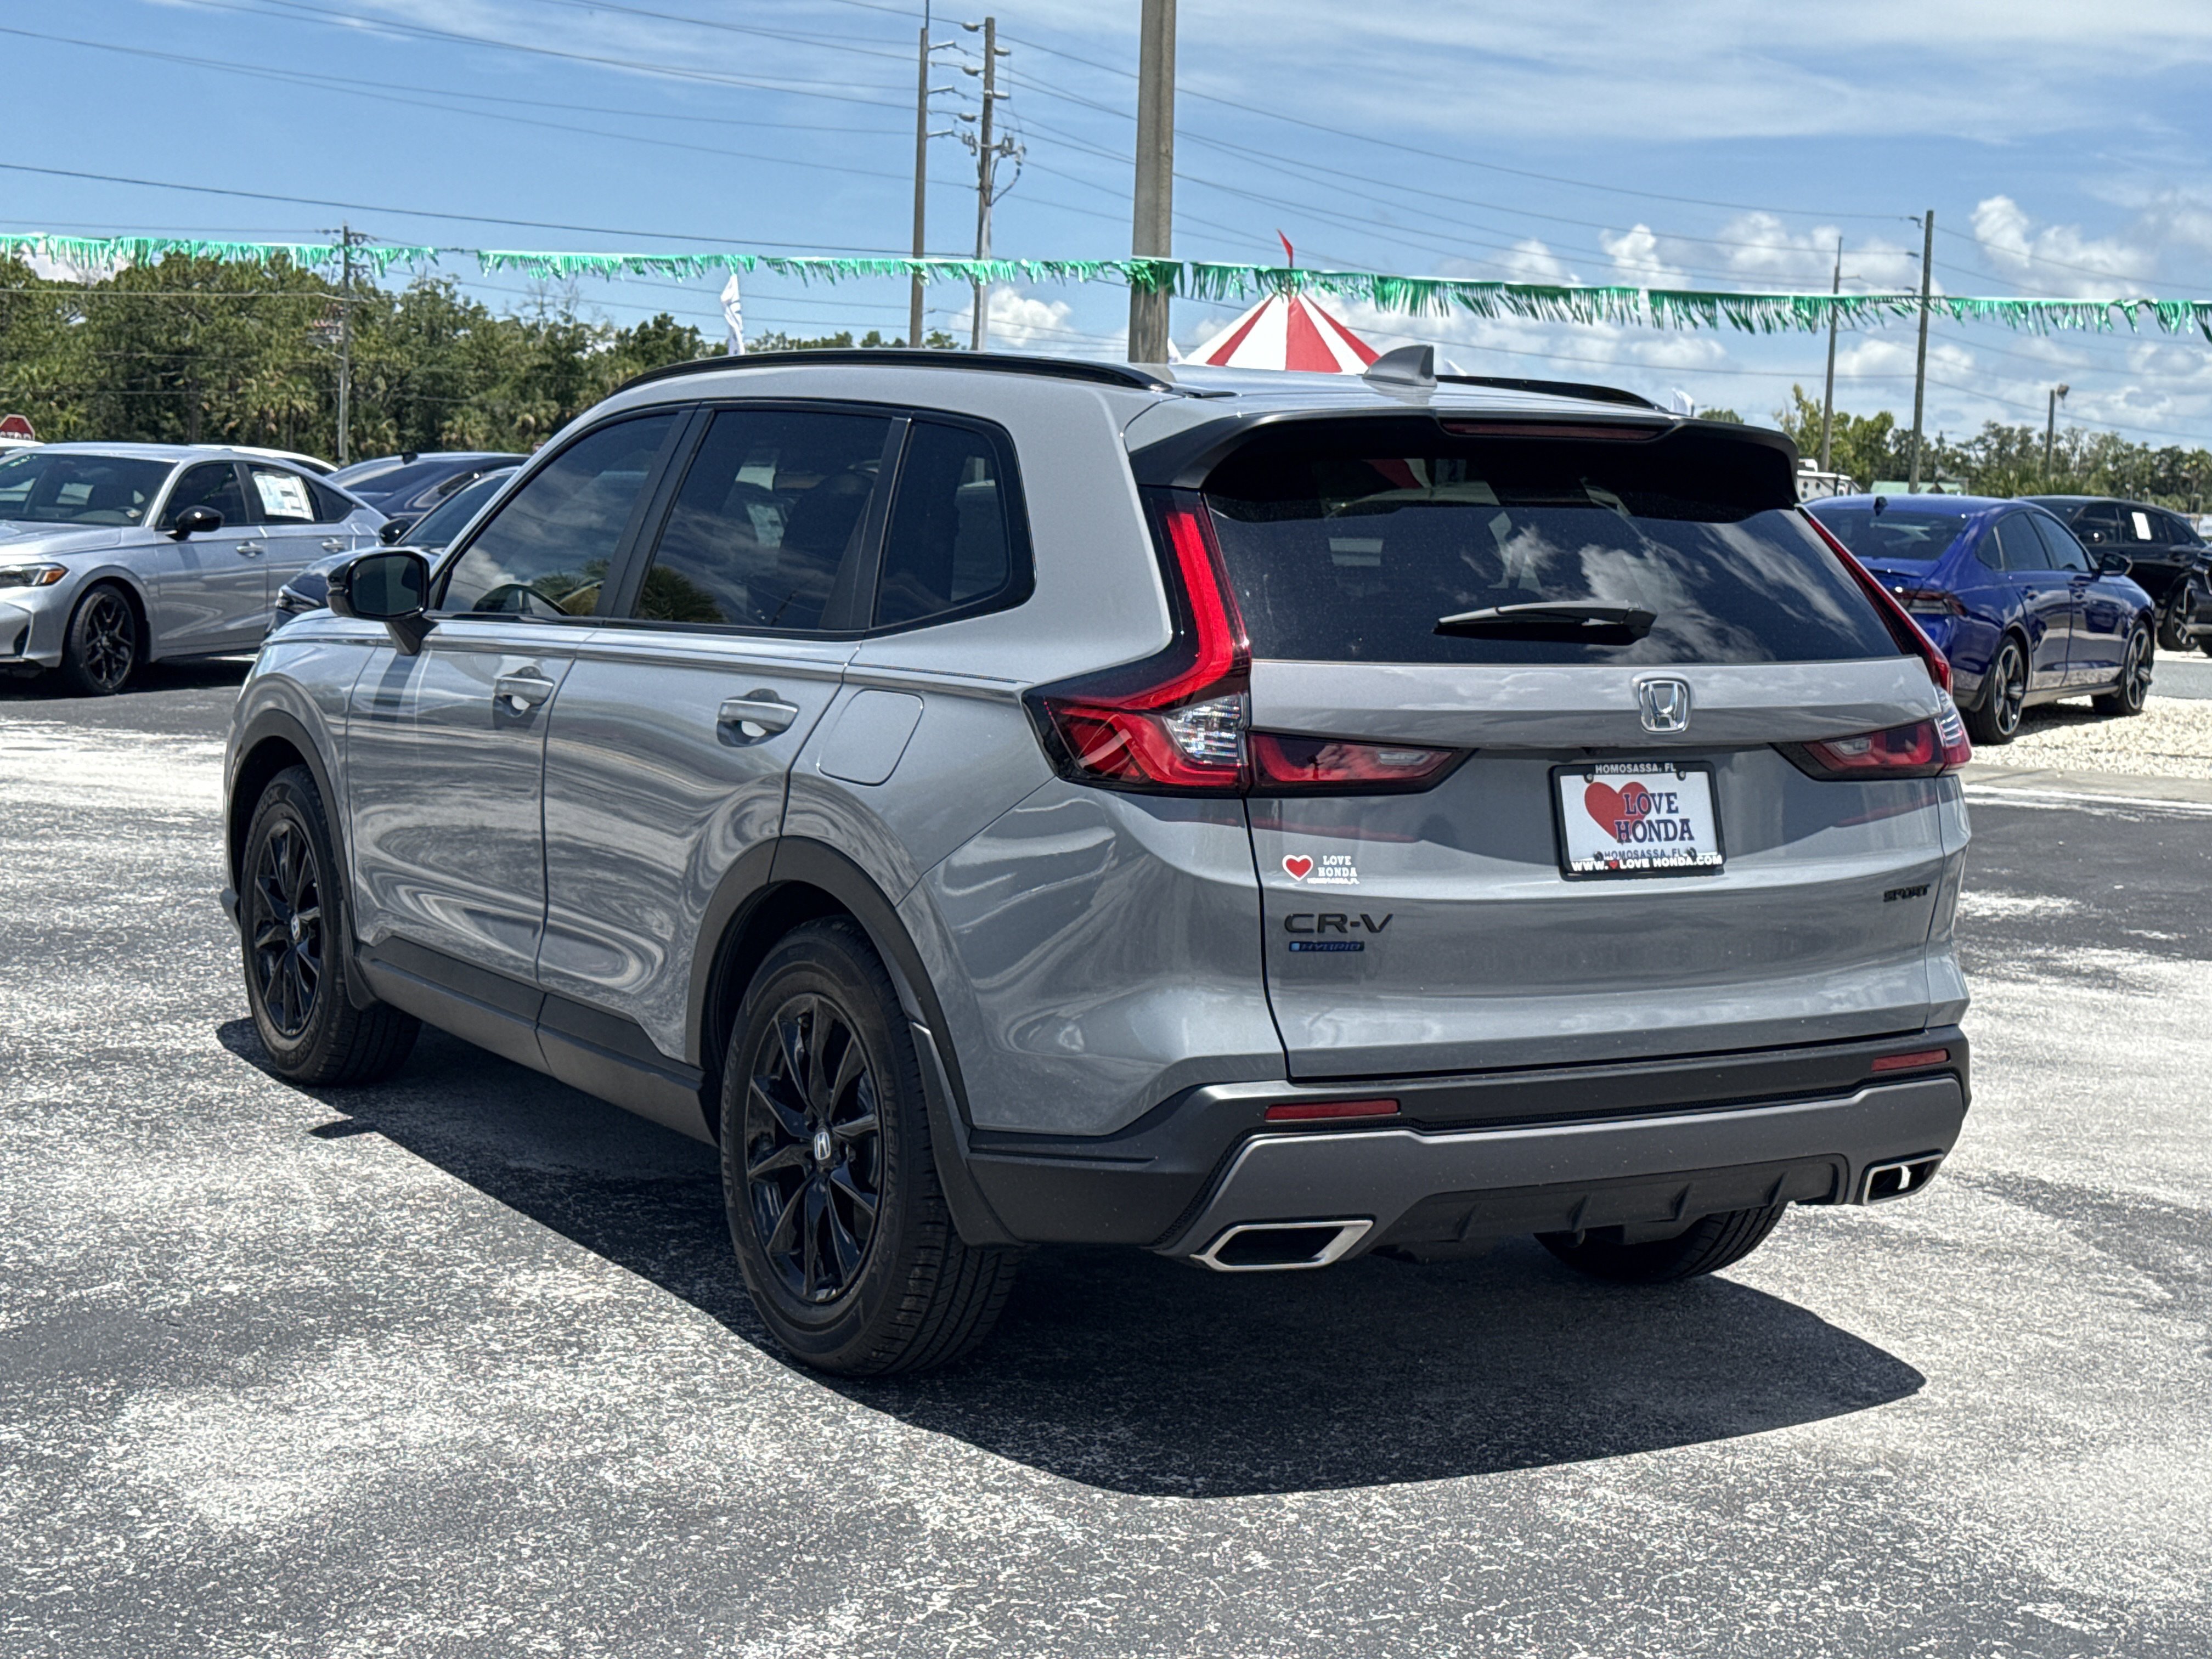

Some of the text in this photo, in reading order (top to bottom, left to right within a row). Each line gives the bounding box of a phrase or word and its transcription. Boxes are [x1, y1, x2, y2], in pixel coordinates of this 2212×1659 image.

[1595, 763, 1677, 774] HOMOSASSA, FL
[1623, 792, 1679, 815] LOVE
[1615, 819, 1695, 843] HONDA
[1323, 855, 1351, 866] LOVE
[1604, 848, 1683, 860] HOMOSASSA, FL
[1620, 858, 1650, 869] LOVE
[1653, 855, 1723, 867] HONDA.COM
[1318, 867, 1358, 877] HONDA
[1284, 913, 1394, 933] CR-V
